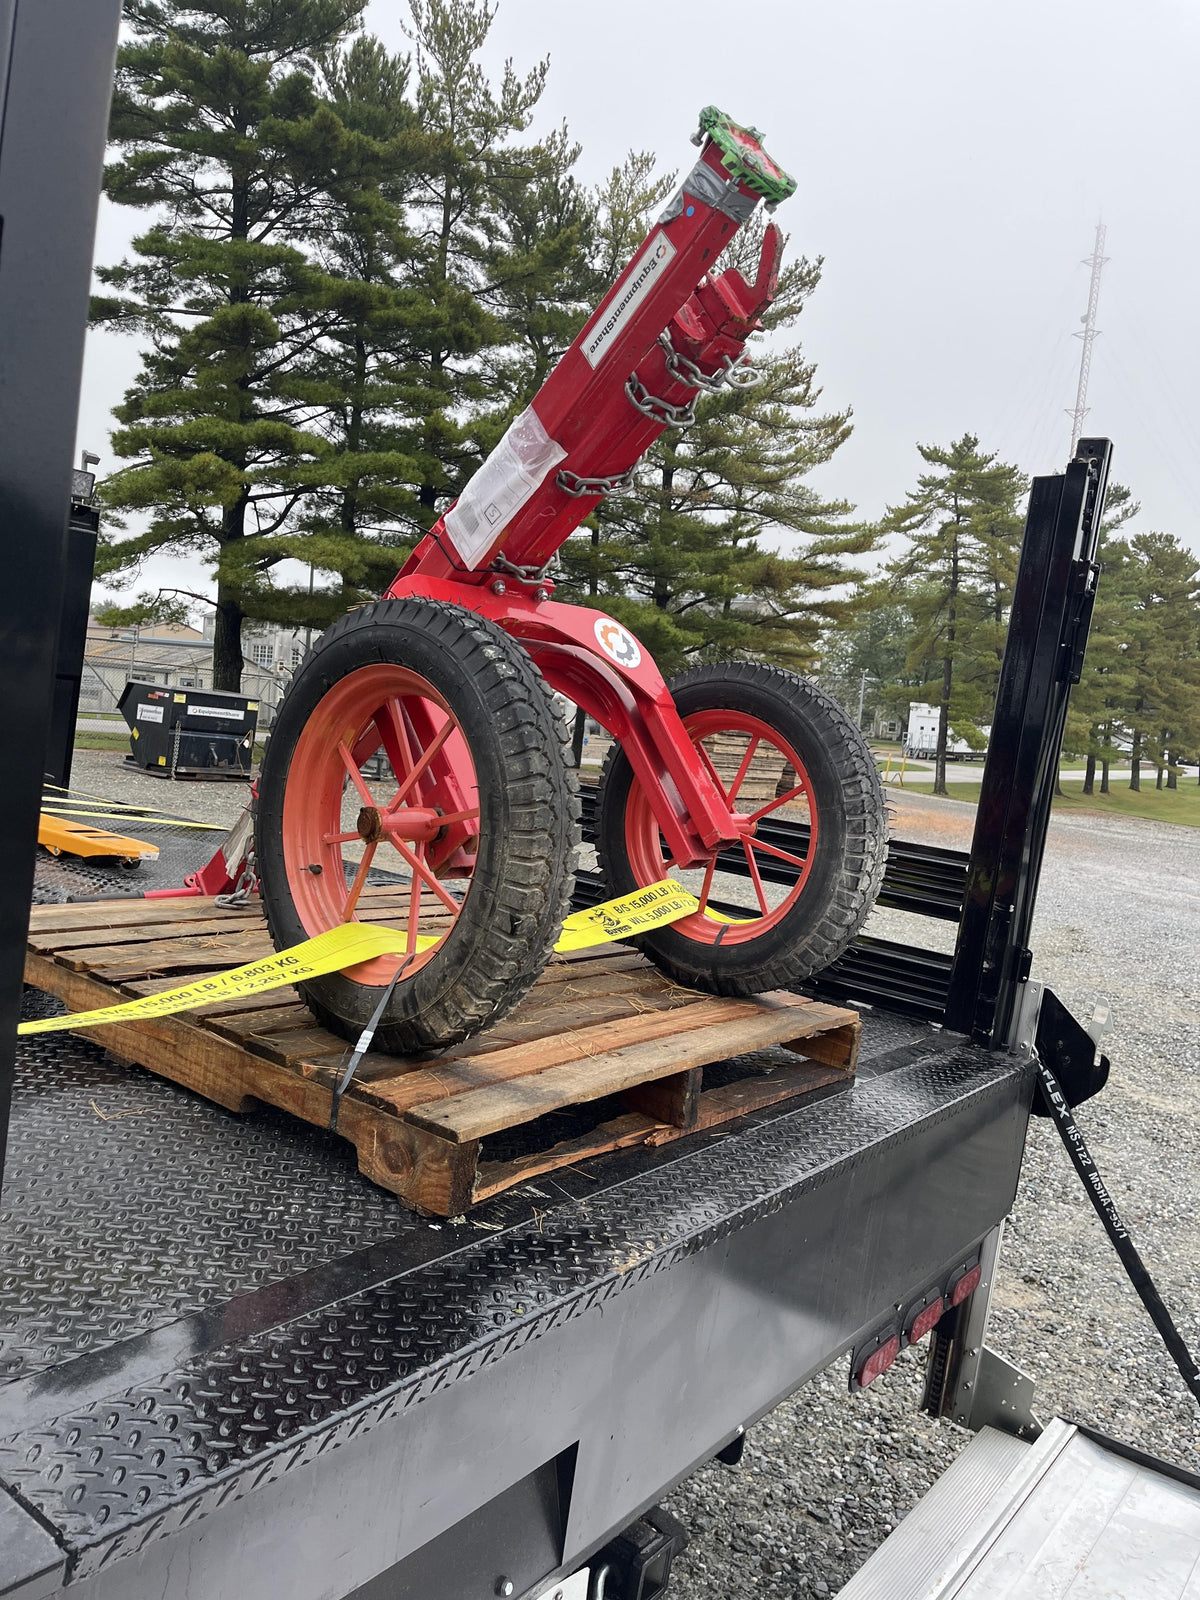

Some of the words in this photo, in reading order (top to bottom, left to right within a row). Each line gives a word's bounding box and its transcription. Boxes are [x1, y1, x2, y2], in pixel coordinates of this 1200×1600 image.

[589, 258, 658, 354] EquipmentShare
[613, 904, 631, 914] B/S
[629, 892, 658, 909] 15,000
[658, 886, 669, 897] LB
[667, 885, 674, 893] /
[629, 914, 648, 926] WLL
[646, 906, 672, 923] 5,000
[668, 900, 682, 910] LB
[604, 925, 632, 936] Buyers
[137, 991, 192, 1009] 15,000
[193, 982, 218, 994] LB
[230, 964, 275, 982] 6,803
[274, 956, 300, 968] KG
[244, 973, 287, 989] 2,267
[290, 966, 315, 976] KG
[1066, 1125, 1092, 1166] NS-122
[1088, 1172, 1111, 1207] MSHA
